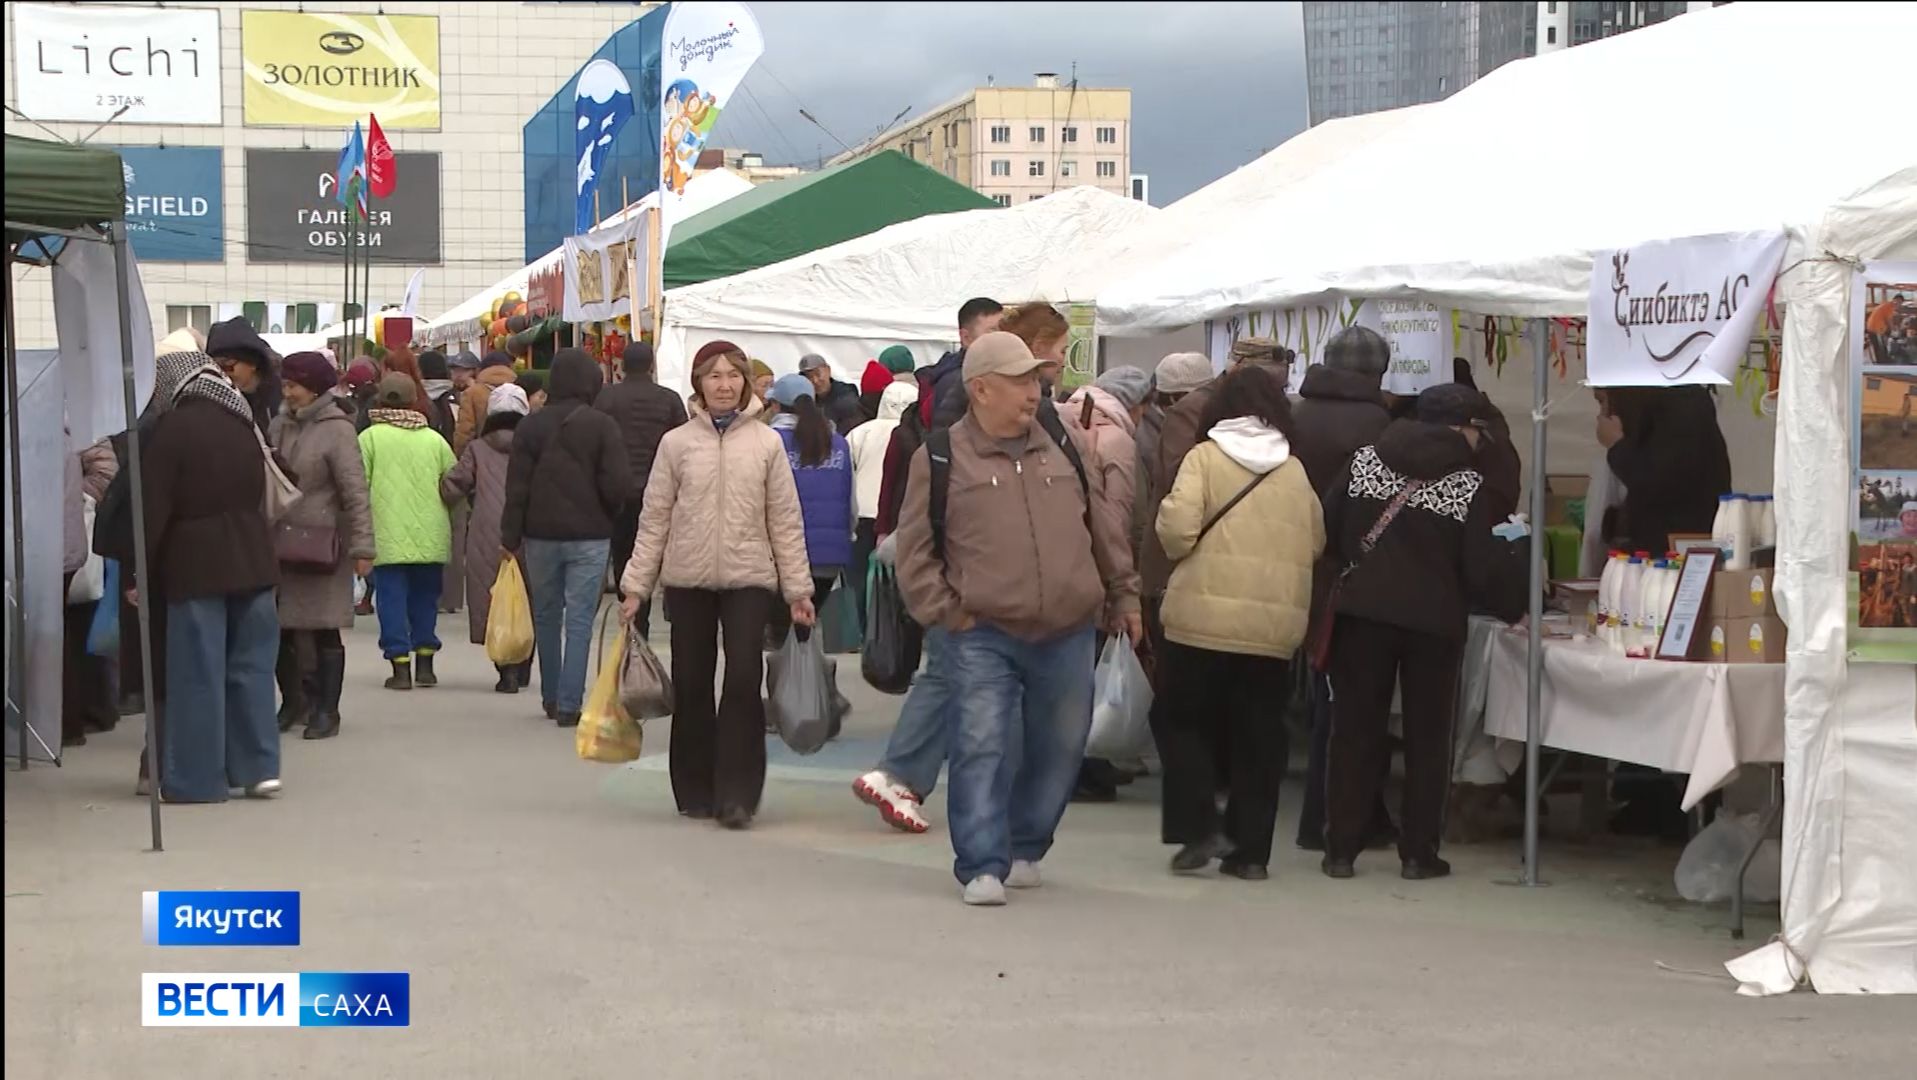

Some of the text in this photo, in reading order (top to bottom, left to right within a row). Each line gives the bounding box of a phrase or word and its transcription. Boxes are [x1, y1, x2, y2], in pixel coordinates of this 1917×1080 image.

[670, 27, 740, 57] Молочный
[38, 34, 199, 78] Lichi
[263, 63, 420, 88] ЗОЛОТНИК
[96, 95, 146, 106] 2 ЭТАЖ
[124, 195, 208, 217] GFIELD
[297, 209, 392, 226] ГАЛЕЕЯ
